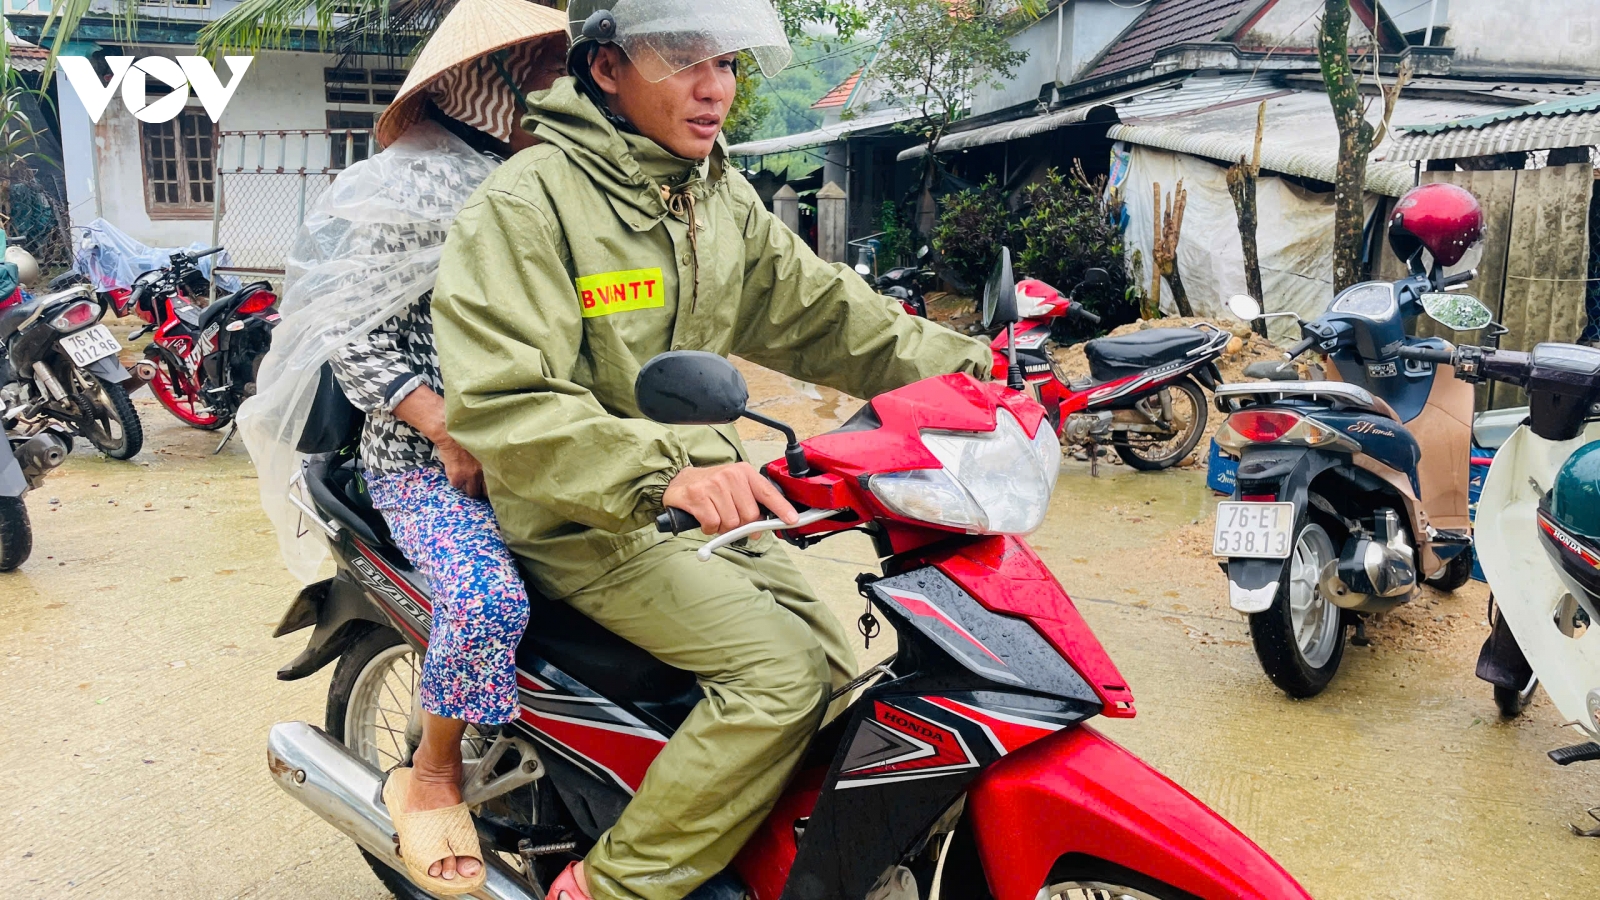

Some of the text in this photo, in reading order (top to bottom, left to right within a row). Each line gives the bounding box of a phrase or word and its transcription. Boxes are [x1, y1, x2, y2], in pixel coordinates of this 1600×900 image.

[68, 329, 104, 349] 76-K1
[1024, 362, 1051, 373] YAMAHA
[1228, 506, 1280, 529] 76-E1
[1218, 530, 1287, 553] 538.13
[1553, 529, 1582, 555] HONDA
[883, 711, 944, 743] HONDA
